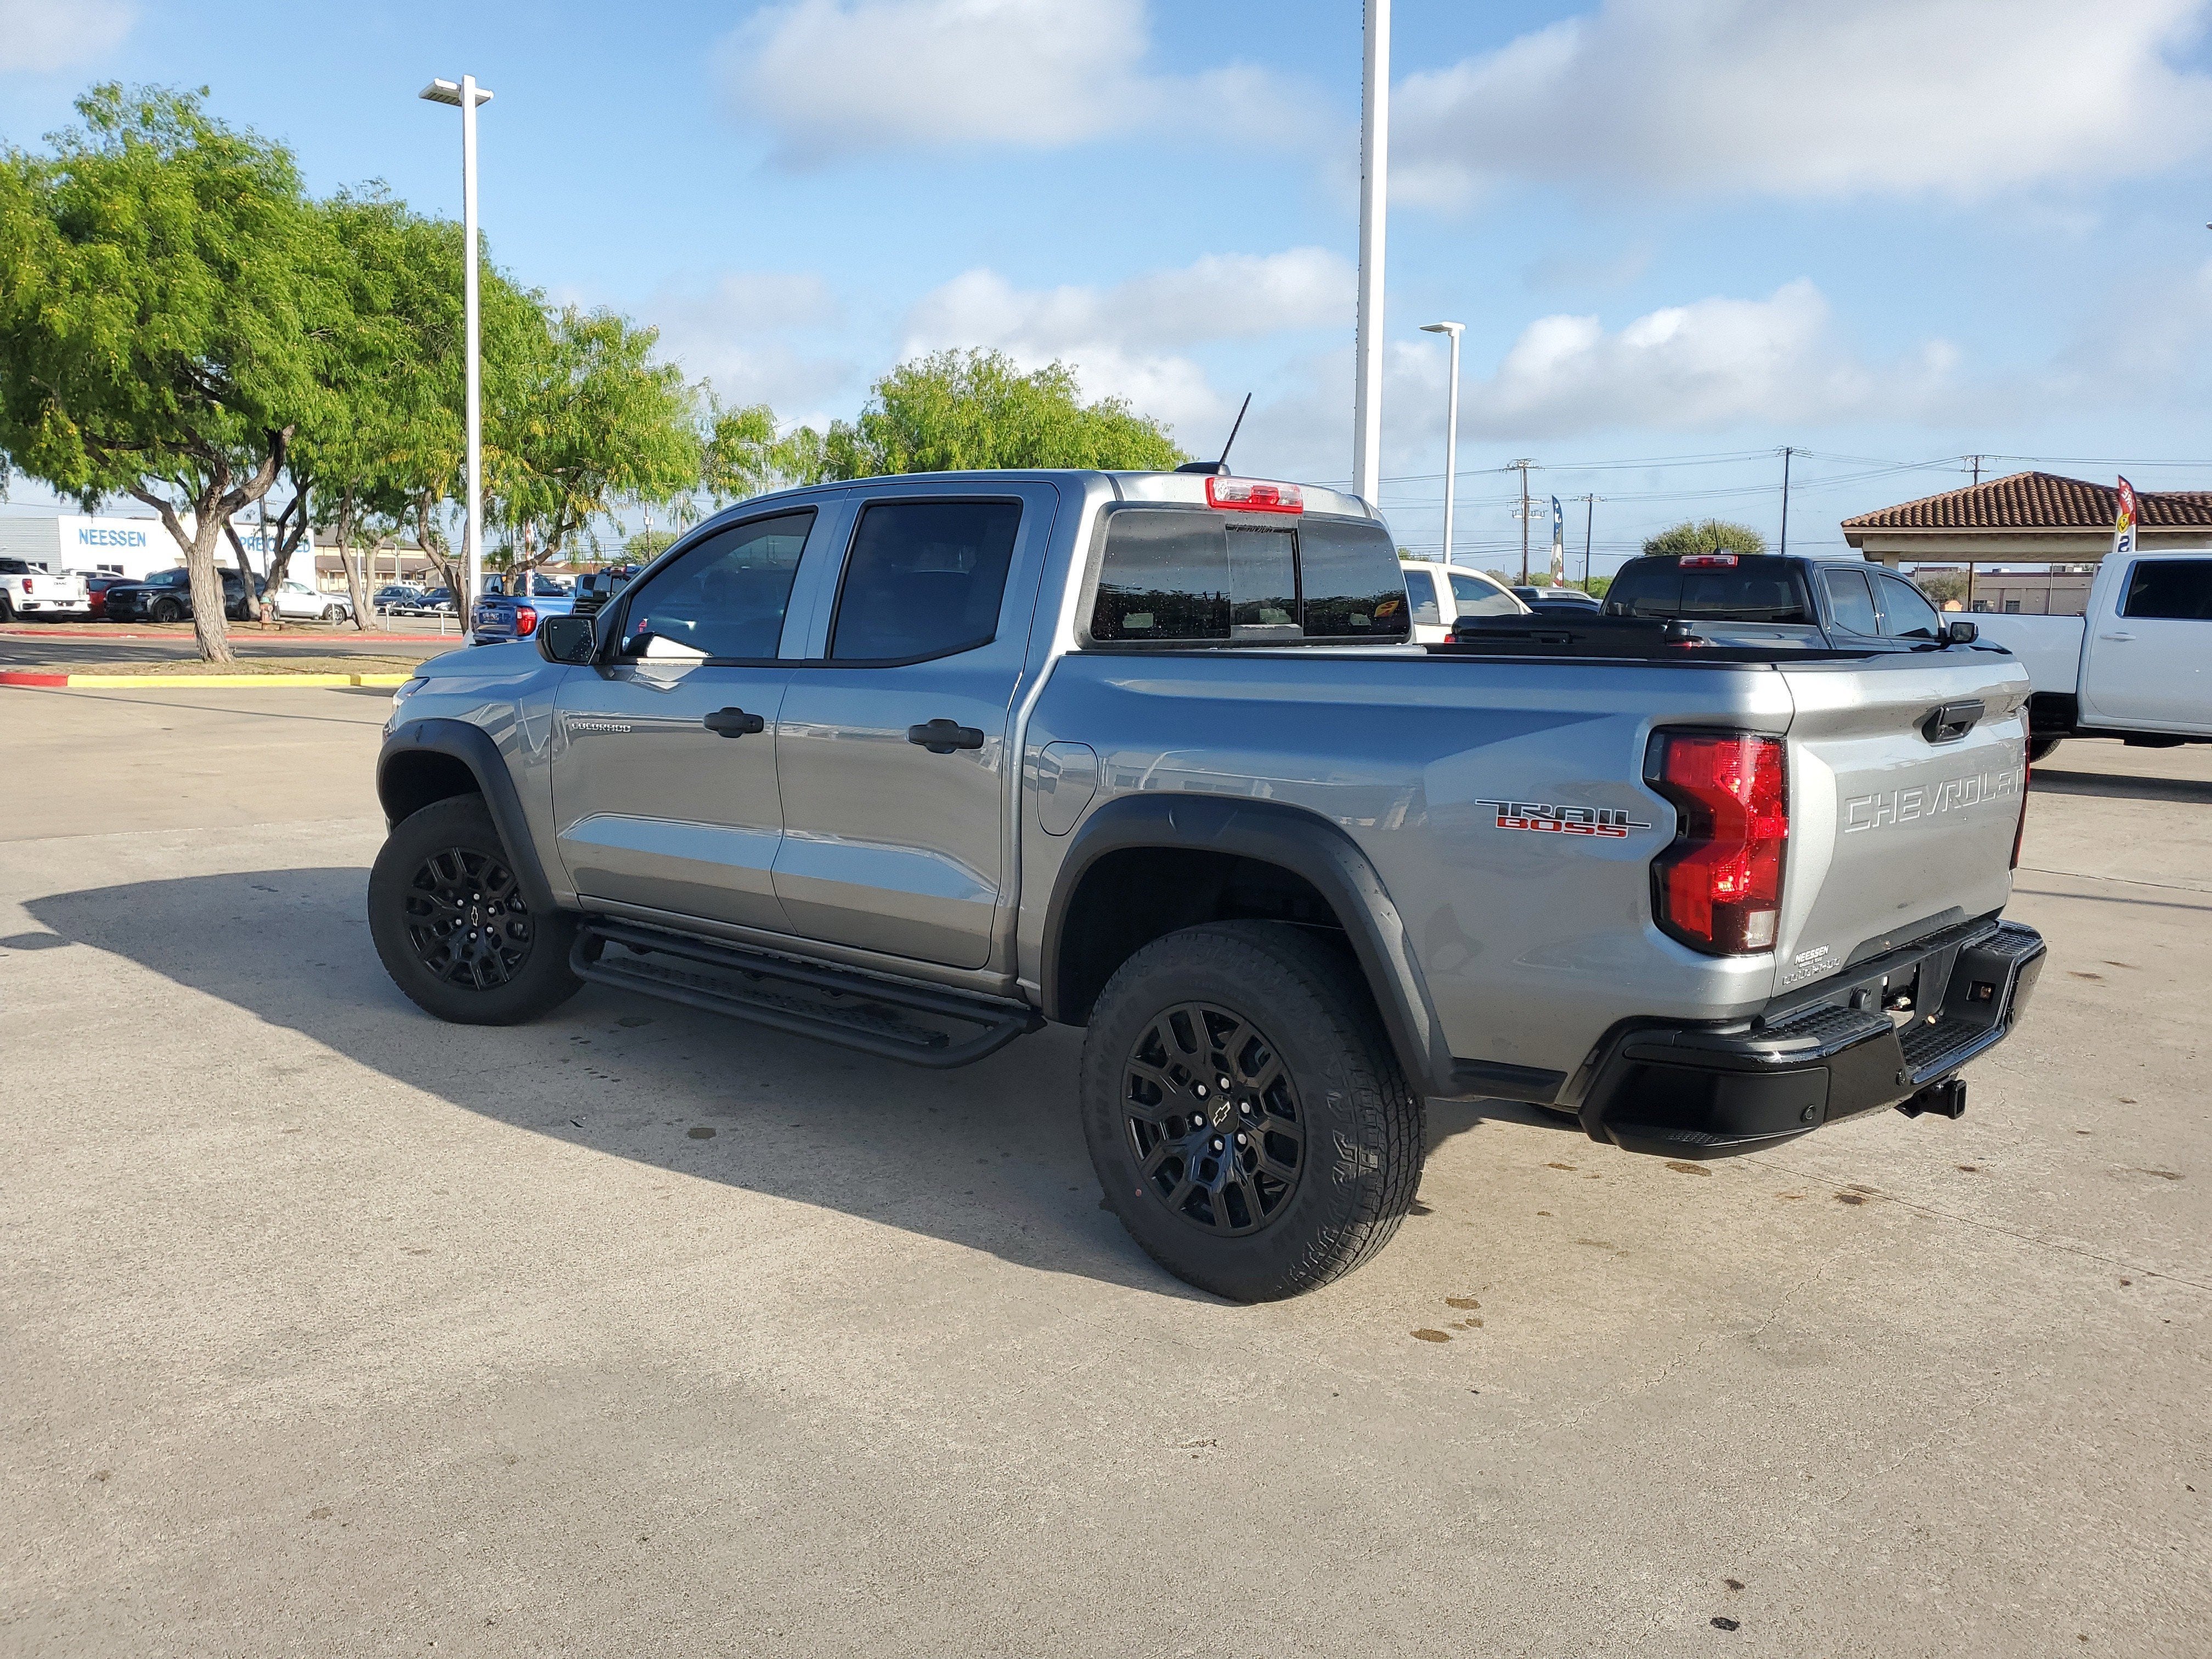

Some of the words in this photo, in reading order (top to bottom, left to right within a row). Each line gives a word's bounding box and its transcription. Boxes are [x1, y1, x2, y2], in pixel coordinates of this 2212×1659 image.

[78, 528, 146, 547] NEESSEN
[572, 722, 631, 732] COLORADO
[1844, 763, 2023, 833] CHEVROLET
[1475, 799, 1652, 829] TRAIL
[1496, 816, 1629, 839] BOSS
[1795, 944, 1829, 965] NEESSEN
